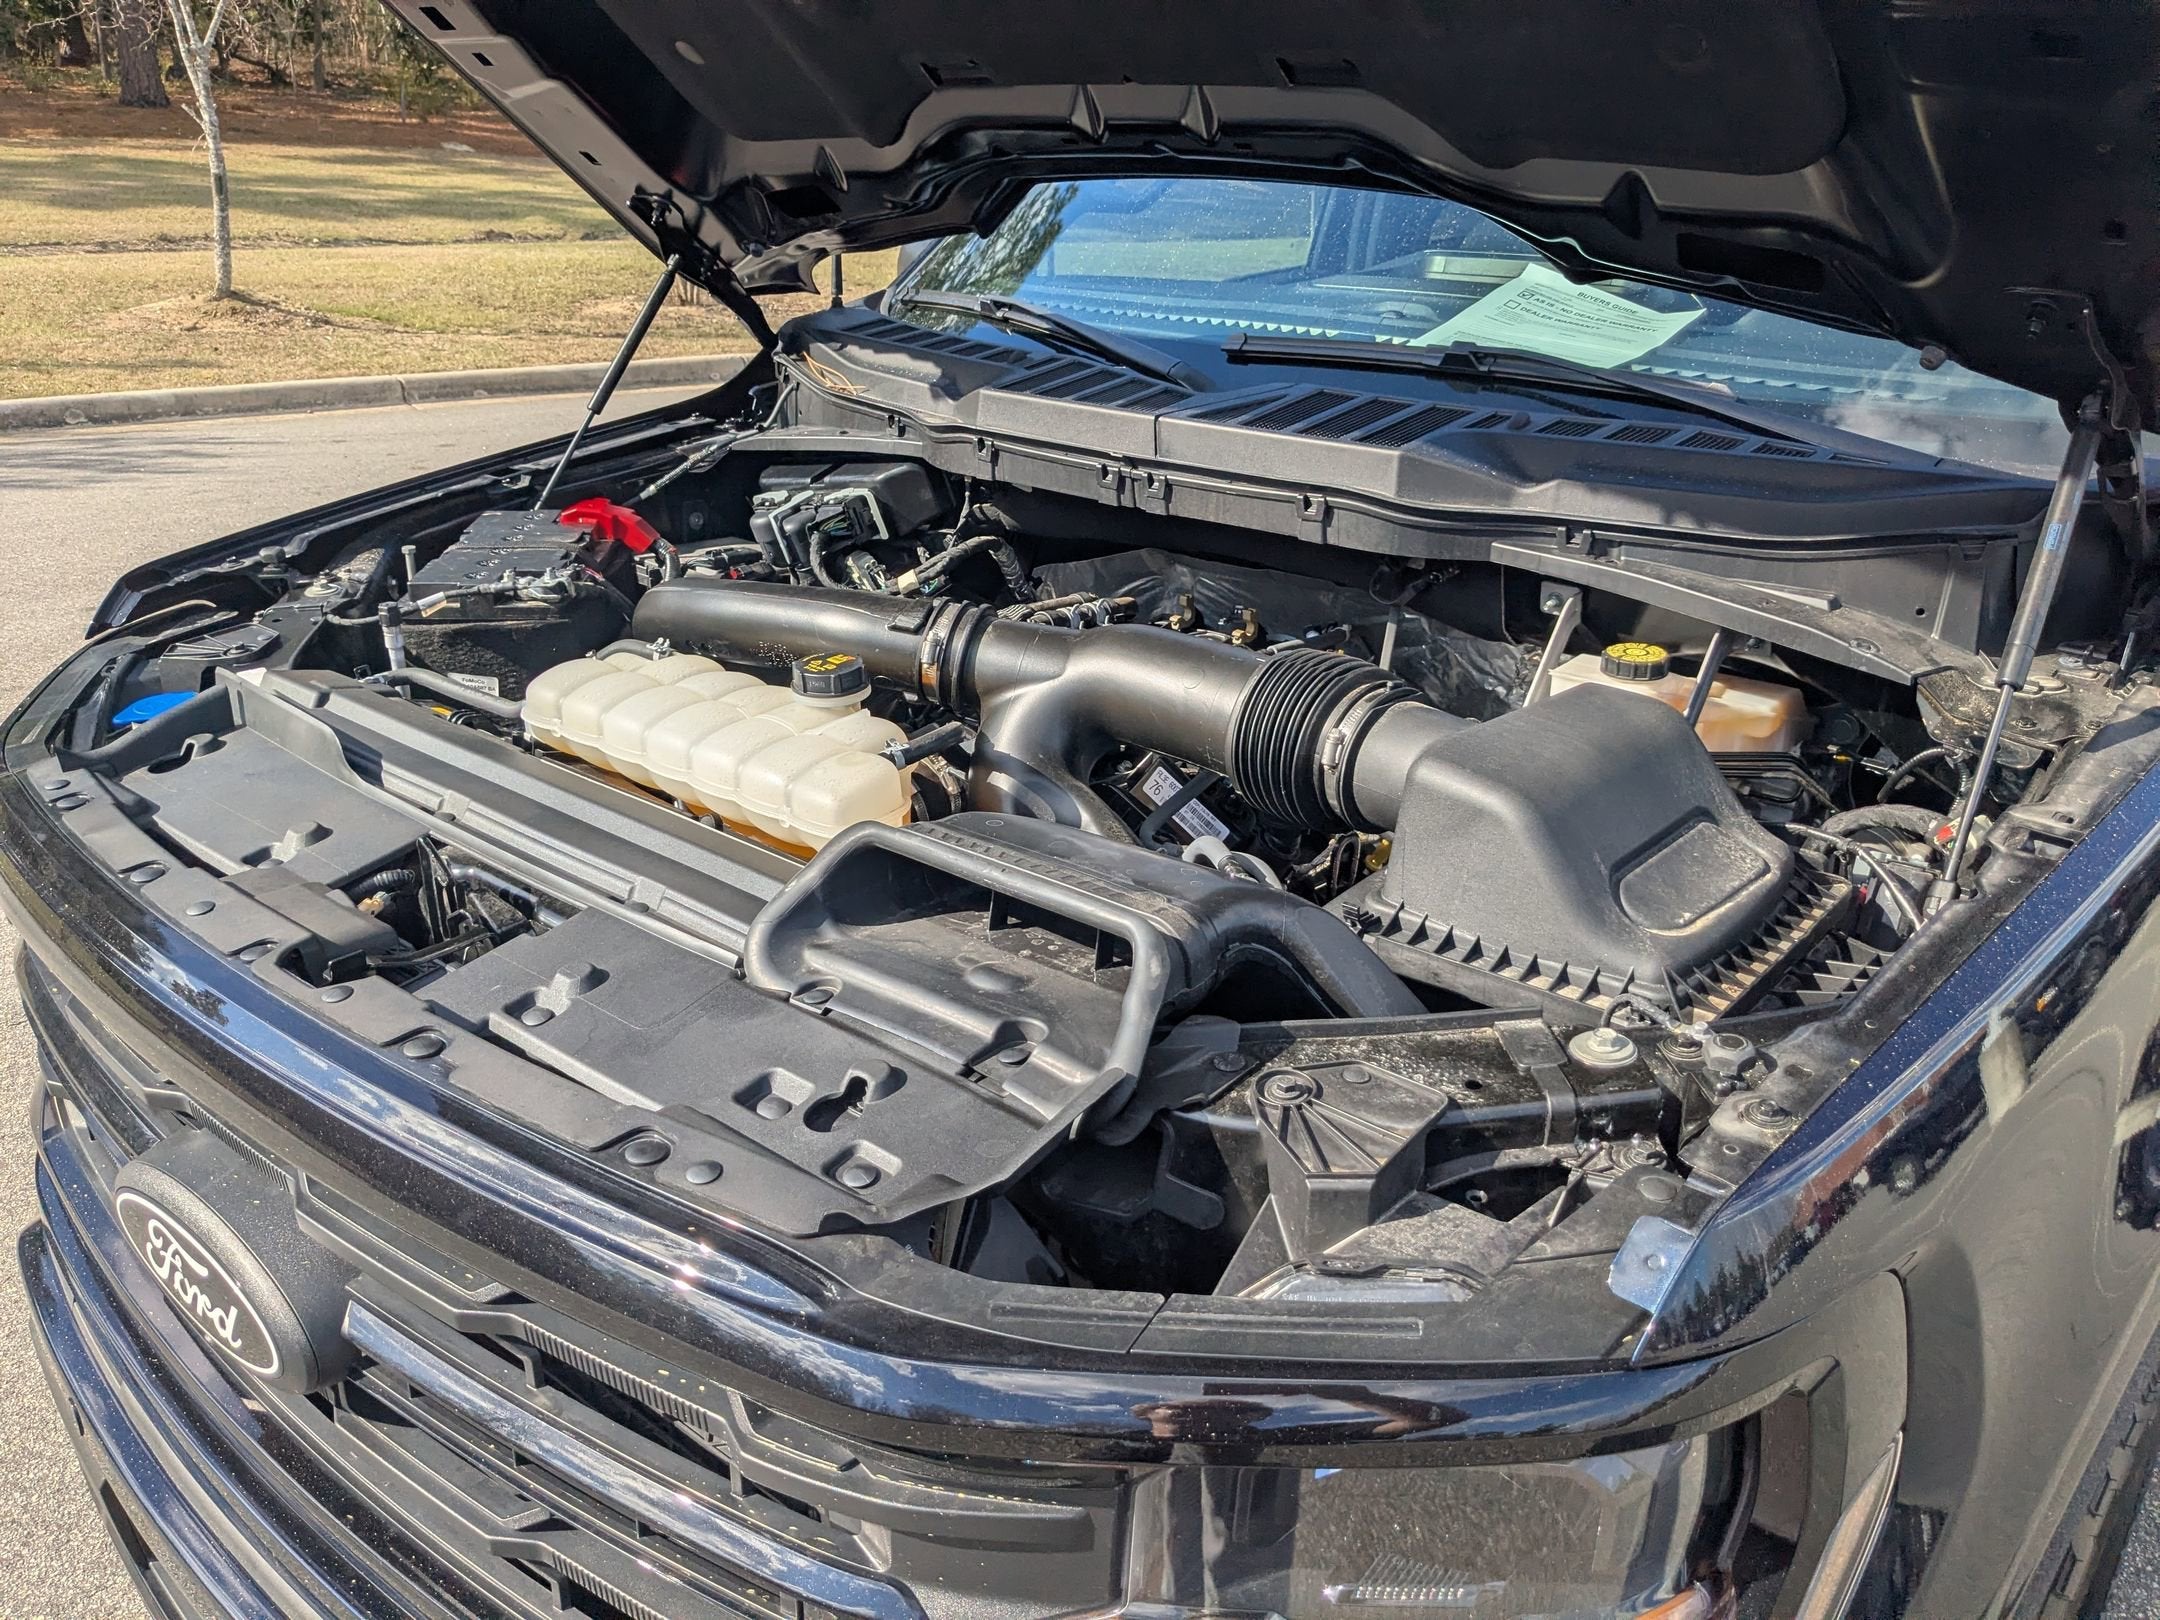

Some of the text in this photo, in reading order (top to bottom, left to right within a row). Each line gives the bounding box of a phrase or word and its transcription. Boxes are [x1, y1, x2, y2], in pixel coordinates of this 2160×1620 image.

[1577, 291, 1639, 314] BUYERS GUIDE
[1520, 306, 1601, 330] DEALER WARRANTY
[1560, 307, 1573, 315] NO
[1574, 312, 1608, 323] DEALER
[1609, 321, 1658, 332] WARRANTY
[1149, 779, 1164, 796] 76
[146, 1218, 242, 1348] Ford
